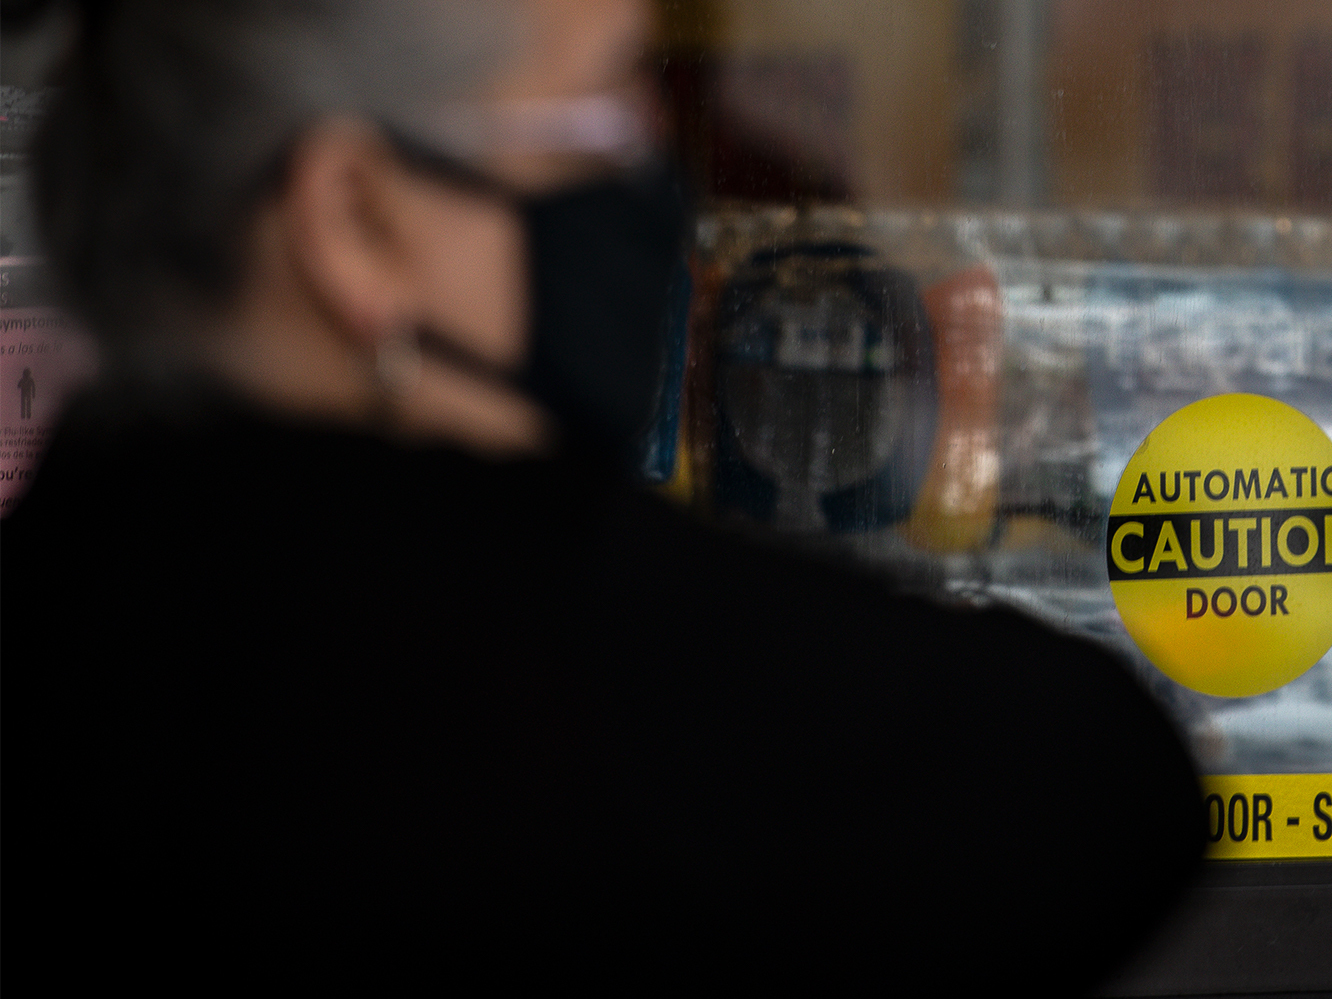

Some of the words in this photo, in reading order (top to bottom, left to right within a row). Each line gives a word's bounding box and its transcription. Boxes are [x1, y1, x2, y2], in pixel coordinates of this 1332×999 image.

[0, 466, 33, 481] ou're
[1186, 584, 1289, 620] DOOR
[1204, 793, 1273, 842] OOR
